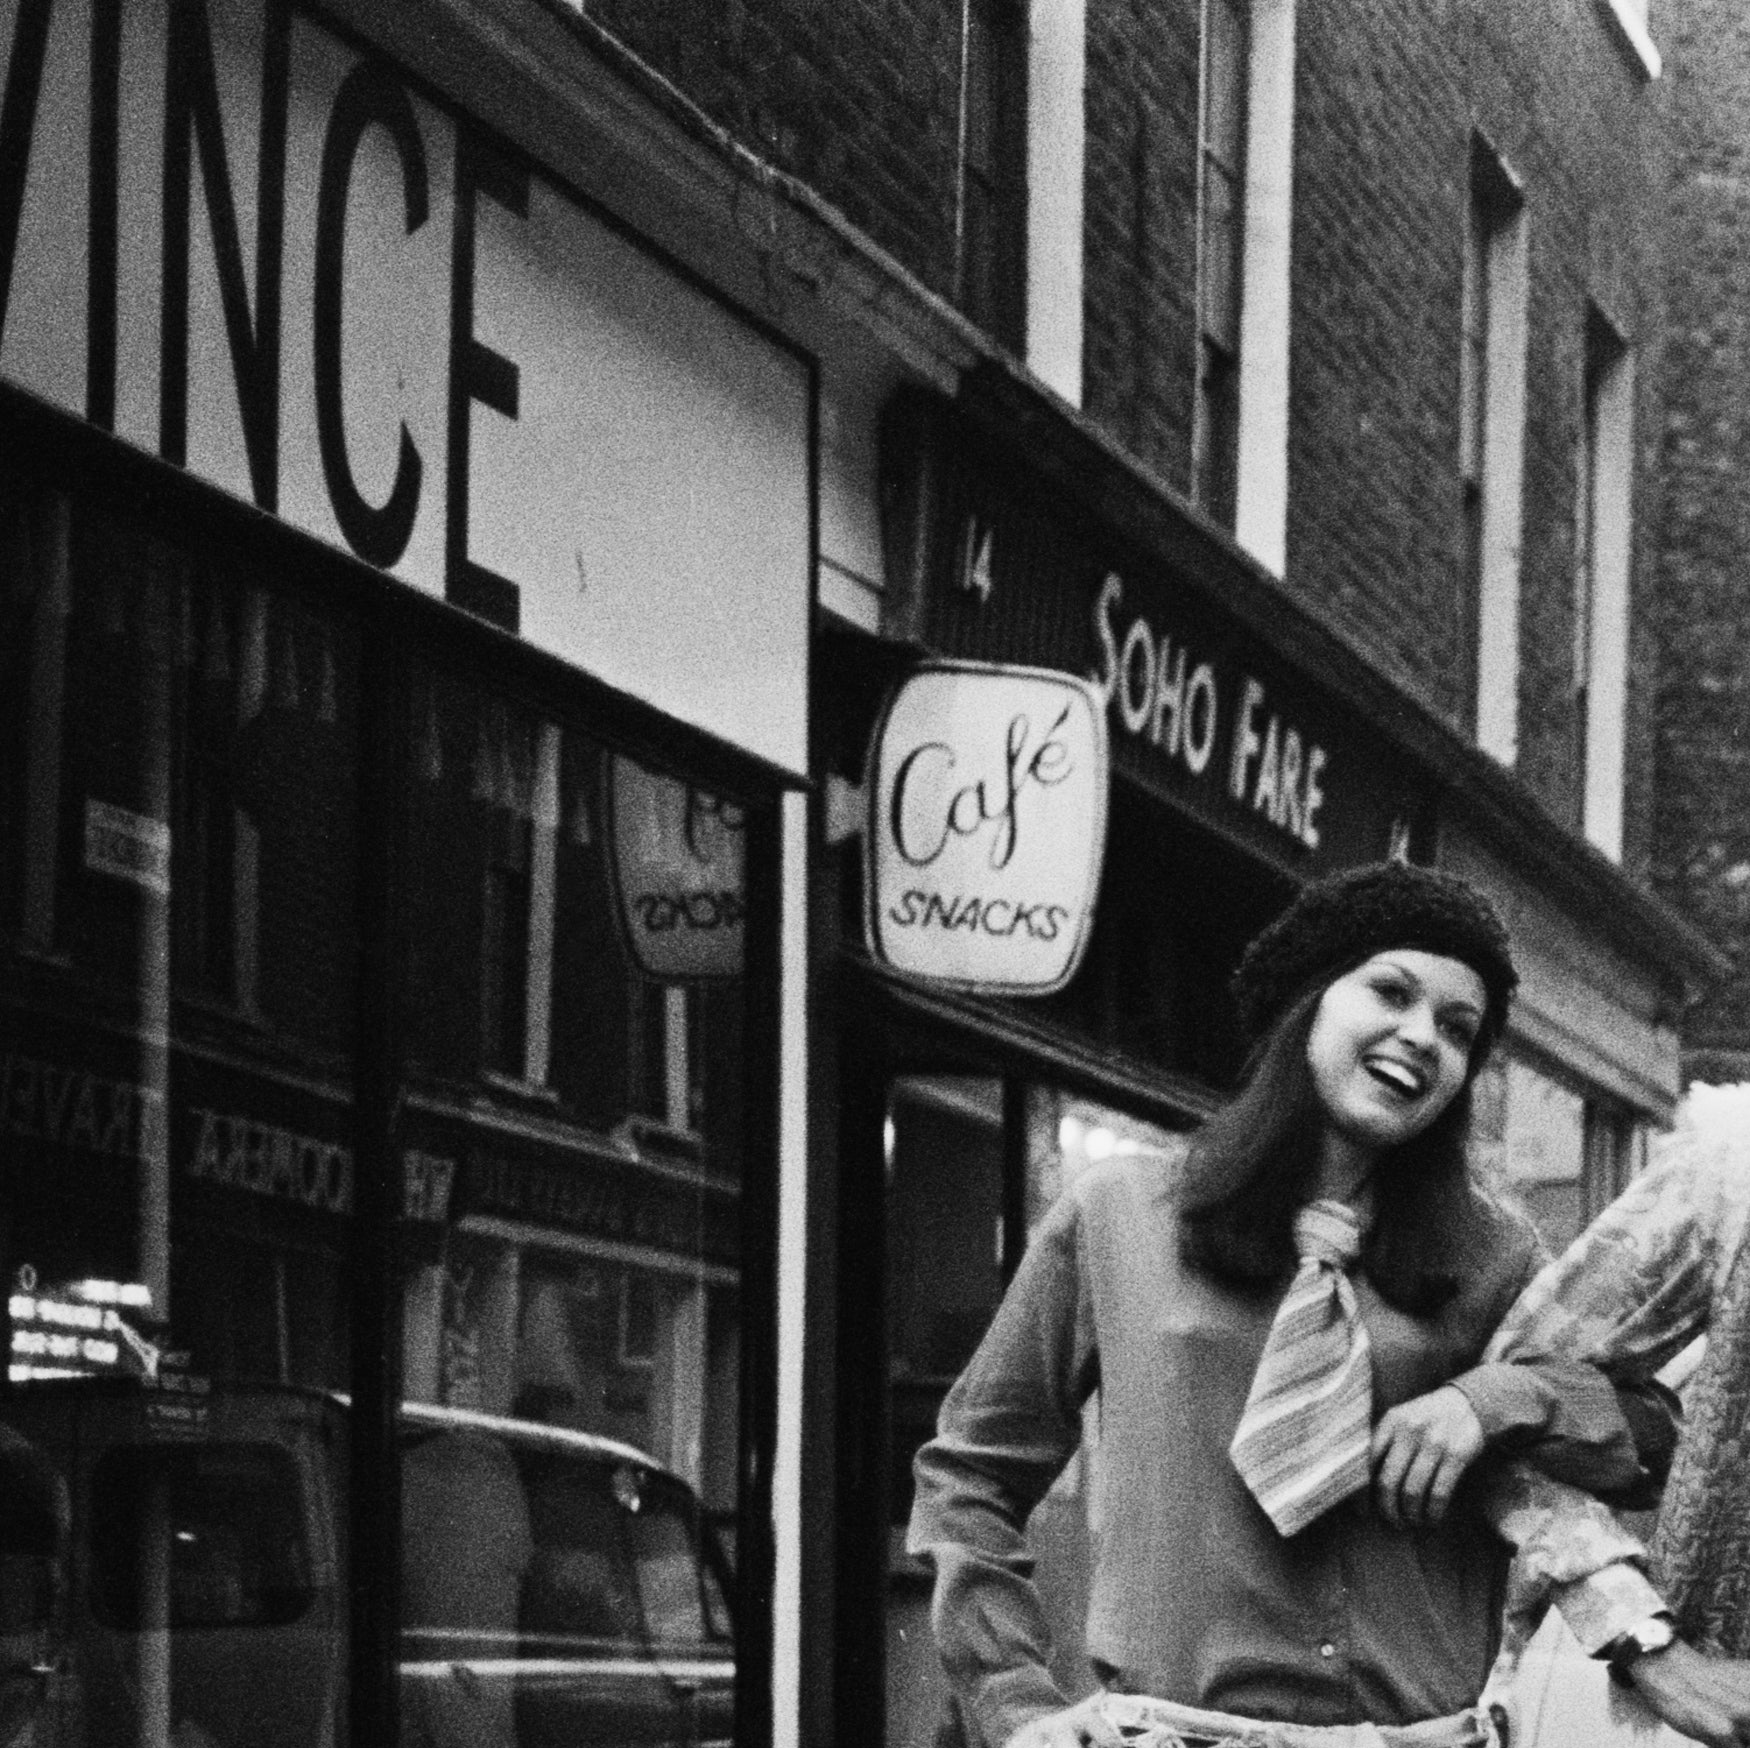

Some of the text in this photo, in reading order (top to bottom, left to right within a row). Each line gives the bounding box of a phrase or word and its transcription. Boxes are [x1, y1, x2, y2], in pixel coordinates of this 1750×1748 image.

[963, 515, 993, 603] 14
[1097, 570, 1217, 776] SOHO
[1230, 677, 1328, 849] FARE
[890, 700, 1073, 871] Café
[889, 887, 1069, 941] SNACKS
